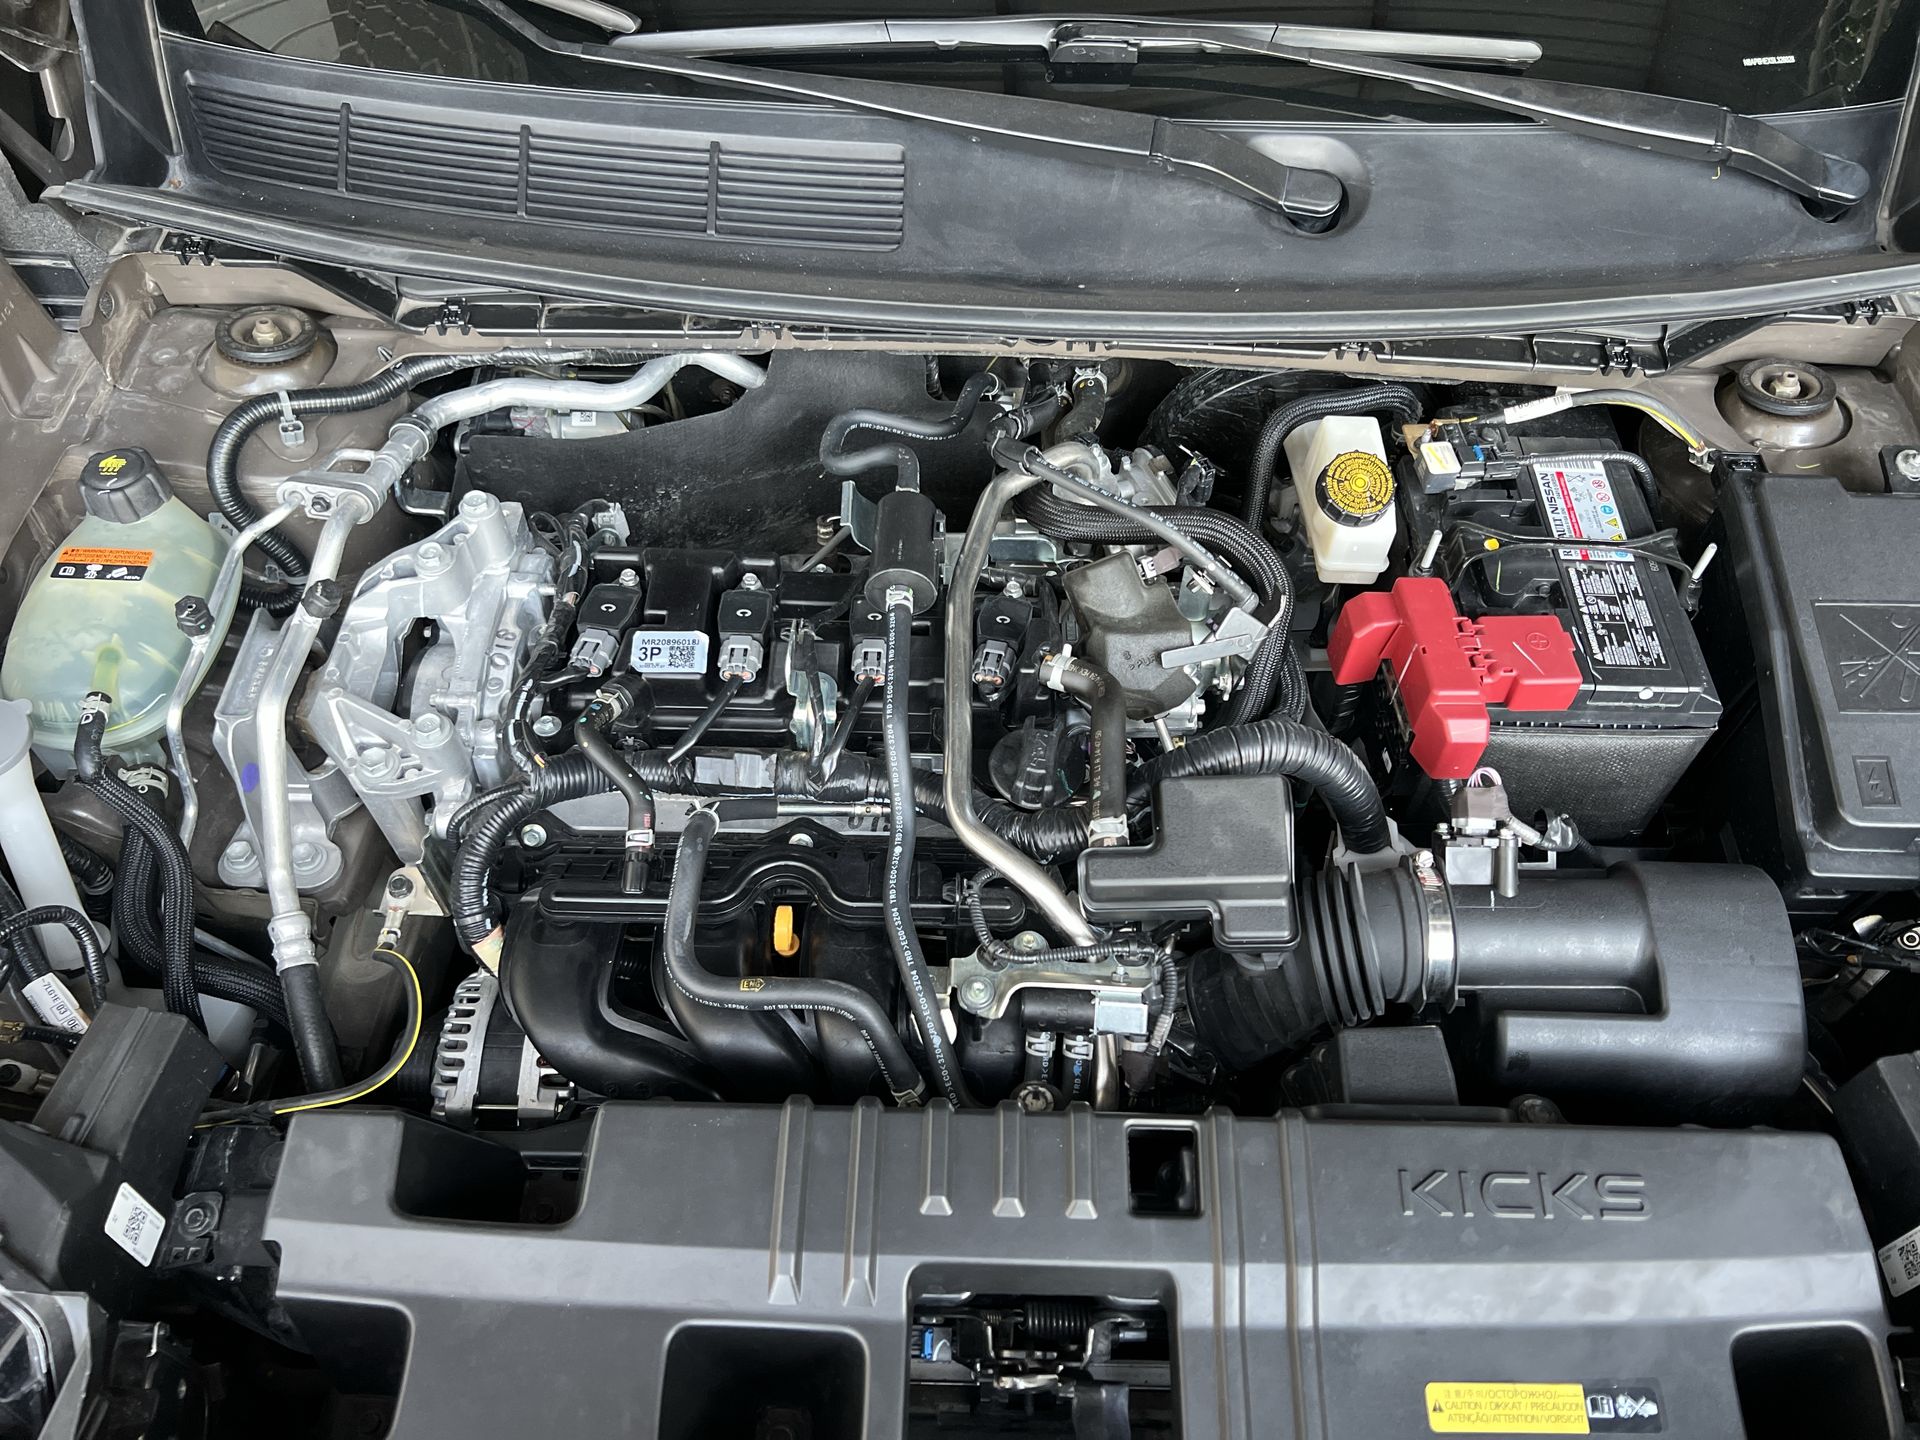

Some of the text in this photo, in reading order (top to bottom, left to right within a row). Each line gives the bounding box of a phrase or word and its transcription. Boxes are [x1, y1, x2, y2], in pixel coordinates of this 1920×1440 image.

[1539, 472, 1560, 514] NISSAN
[638, 646, 661, 662] 3P
[889, 848, 902, 904] TRD>ECO<3Z0
[1398, 1168, 1652, 1222] KICKS
[1445, 1401, 1483, 1410] CAUTION
